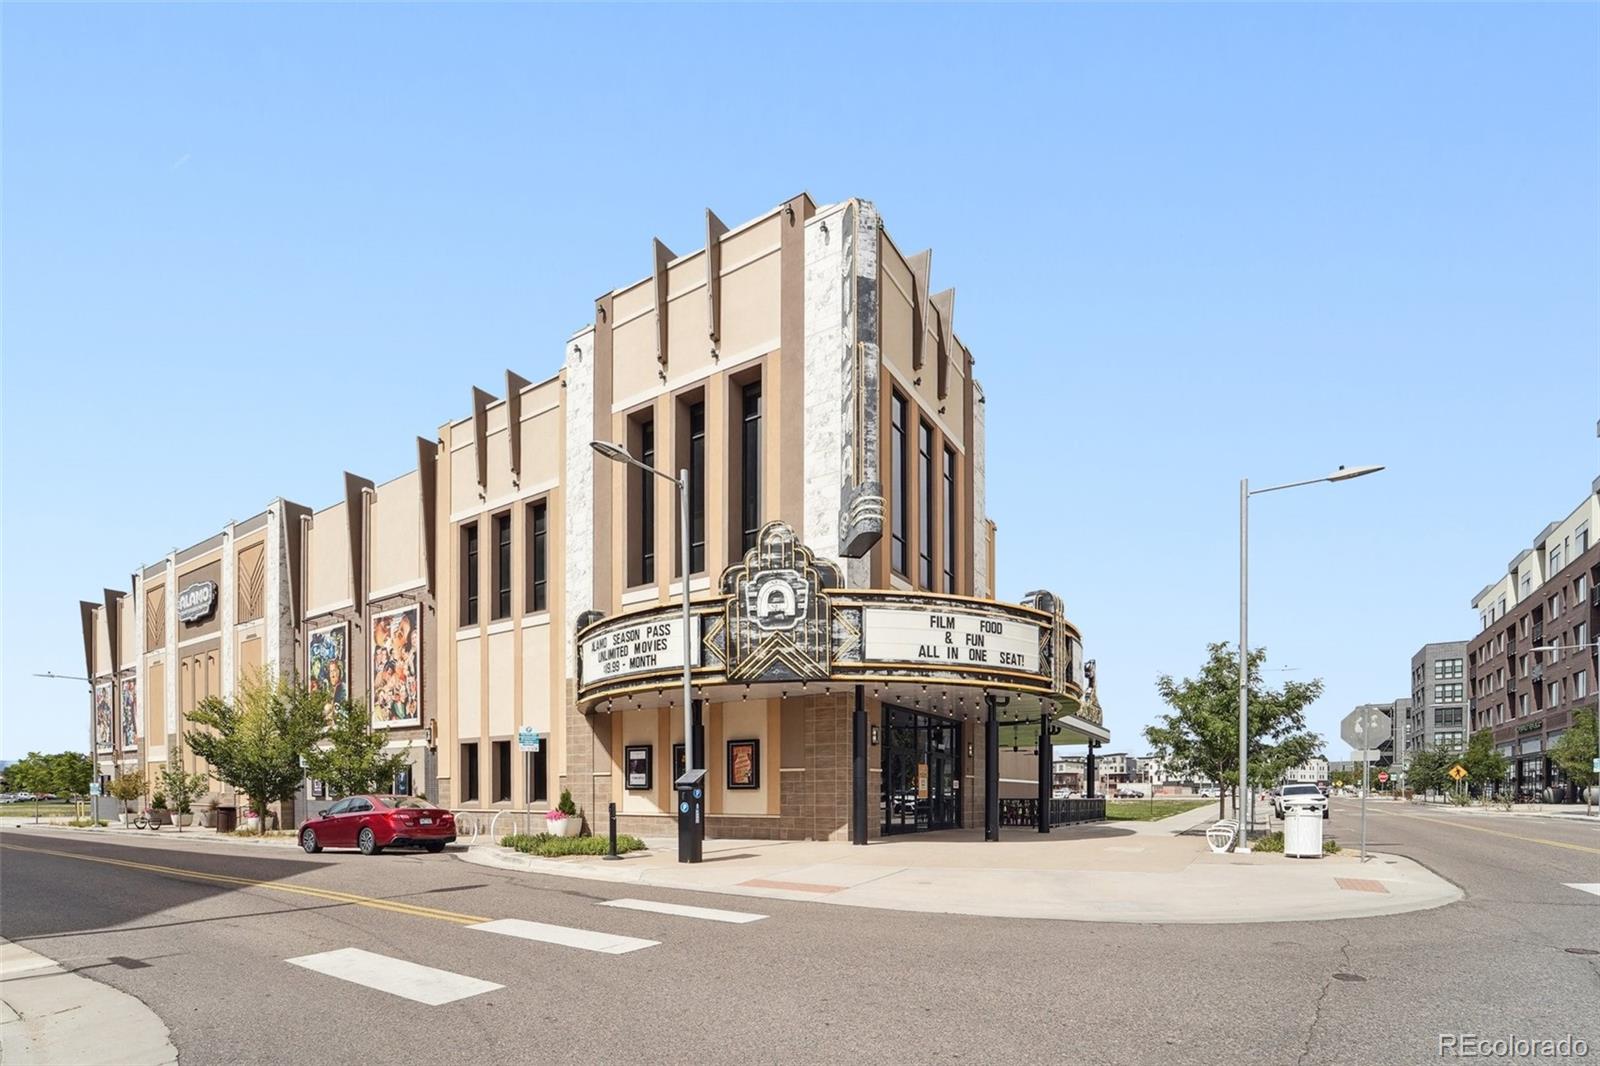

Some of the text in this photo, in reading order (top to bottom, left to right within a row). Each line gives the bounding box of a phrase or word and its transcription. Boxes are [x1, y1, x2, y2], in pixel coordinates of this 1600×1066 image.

[179, 587, 209, 610] ALAMO
[612, 629, 640, 646] SEASON
[646, 623, 671, 639] PASS
[930, 615, 1003, 634] FILM FOOD
[598, 638, 668, 663] UNLIMITED MOVIES
[944, 631, 985, 647] & FUN
[629, 654, 657, 669] MONTH
[918, 644, 1025, 667] ALL IN ONE SEAT!
